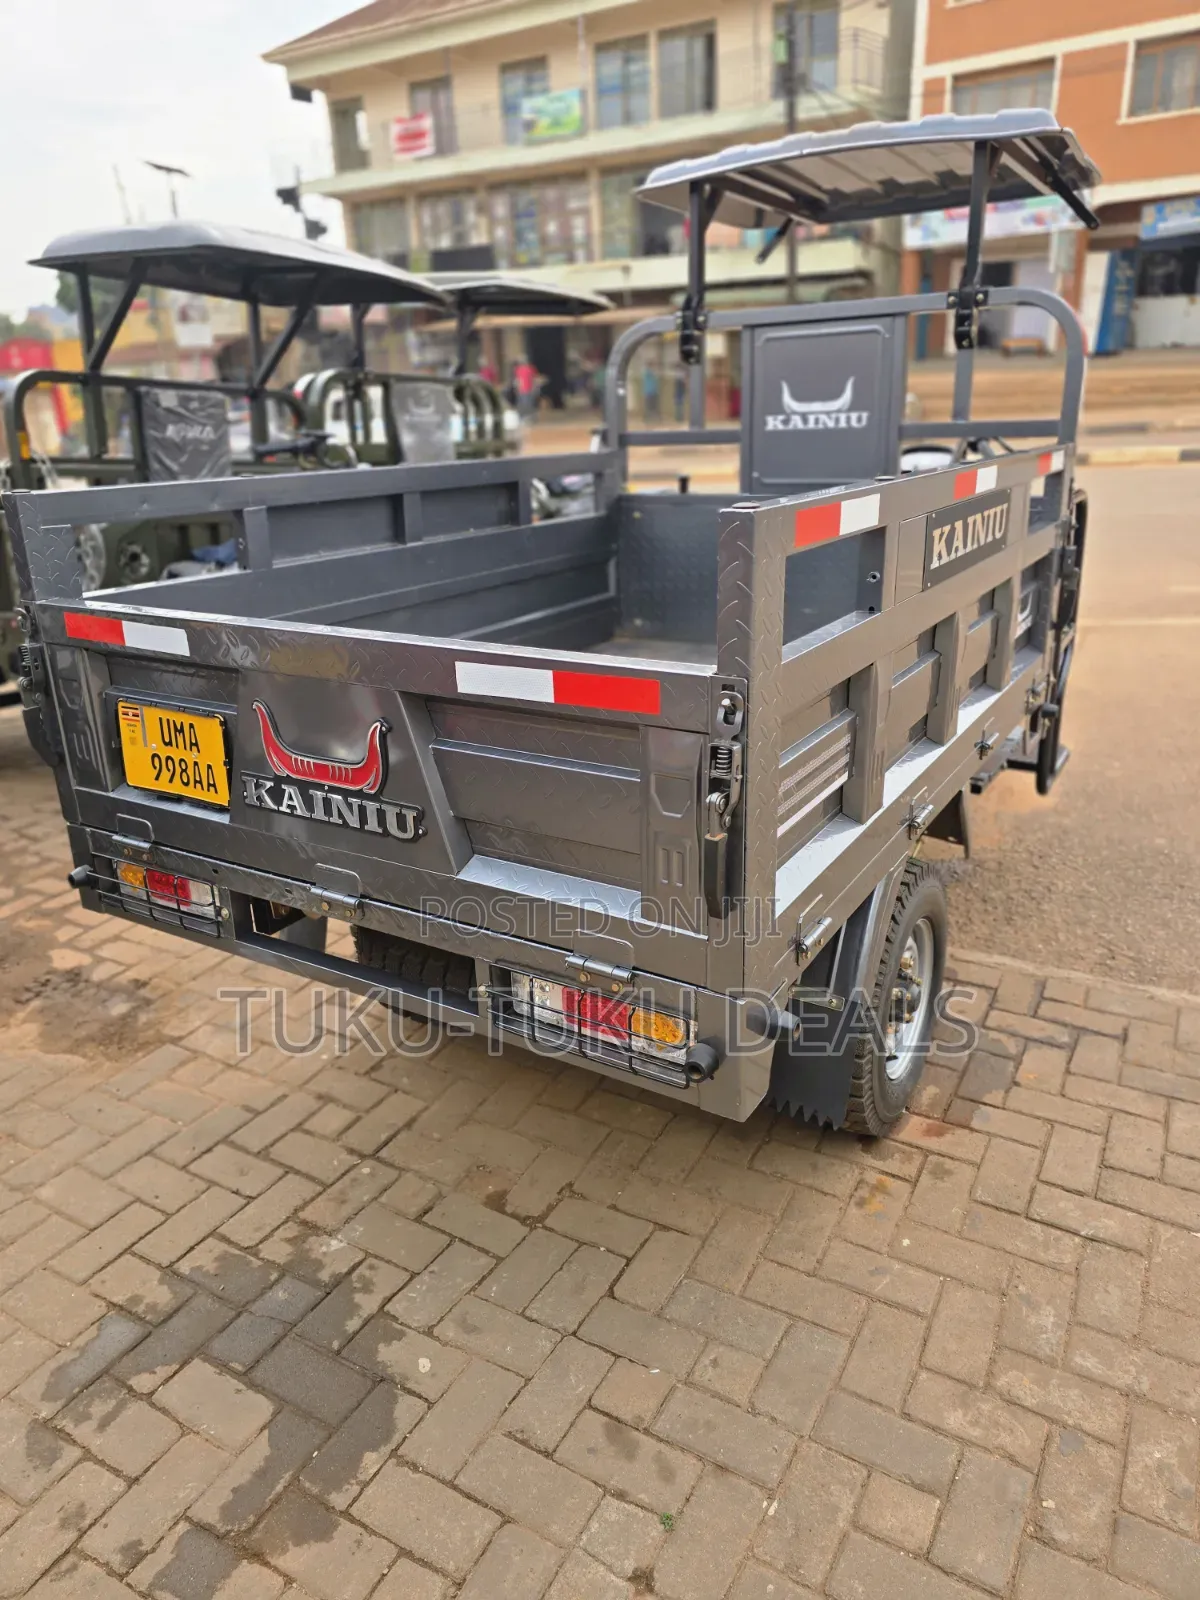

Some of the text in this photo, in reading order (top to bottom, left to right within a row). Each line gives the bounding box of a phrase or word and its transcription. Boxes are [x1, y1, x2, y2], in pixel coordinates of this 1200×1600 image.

[765, 411, 869, 431] KAINIU
[930, 503, 1008, 570] KAINIU
[158, 716, 200, 754] UMA
[151, 752, 218, 794] 998AA
[244, 776, 418, 840] KAINIU
